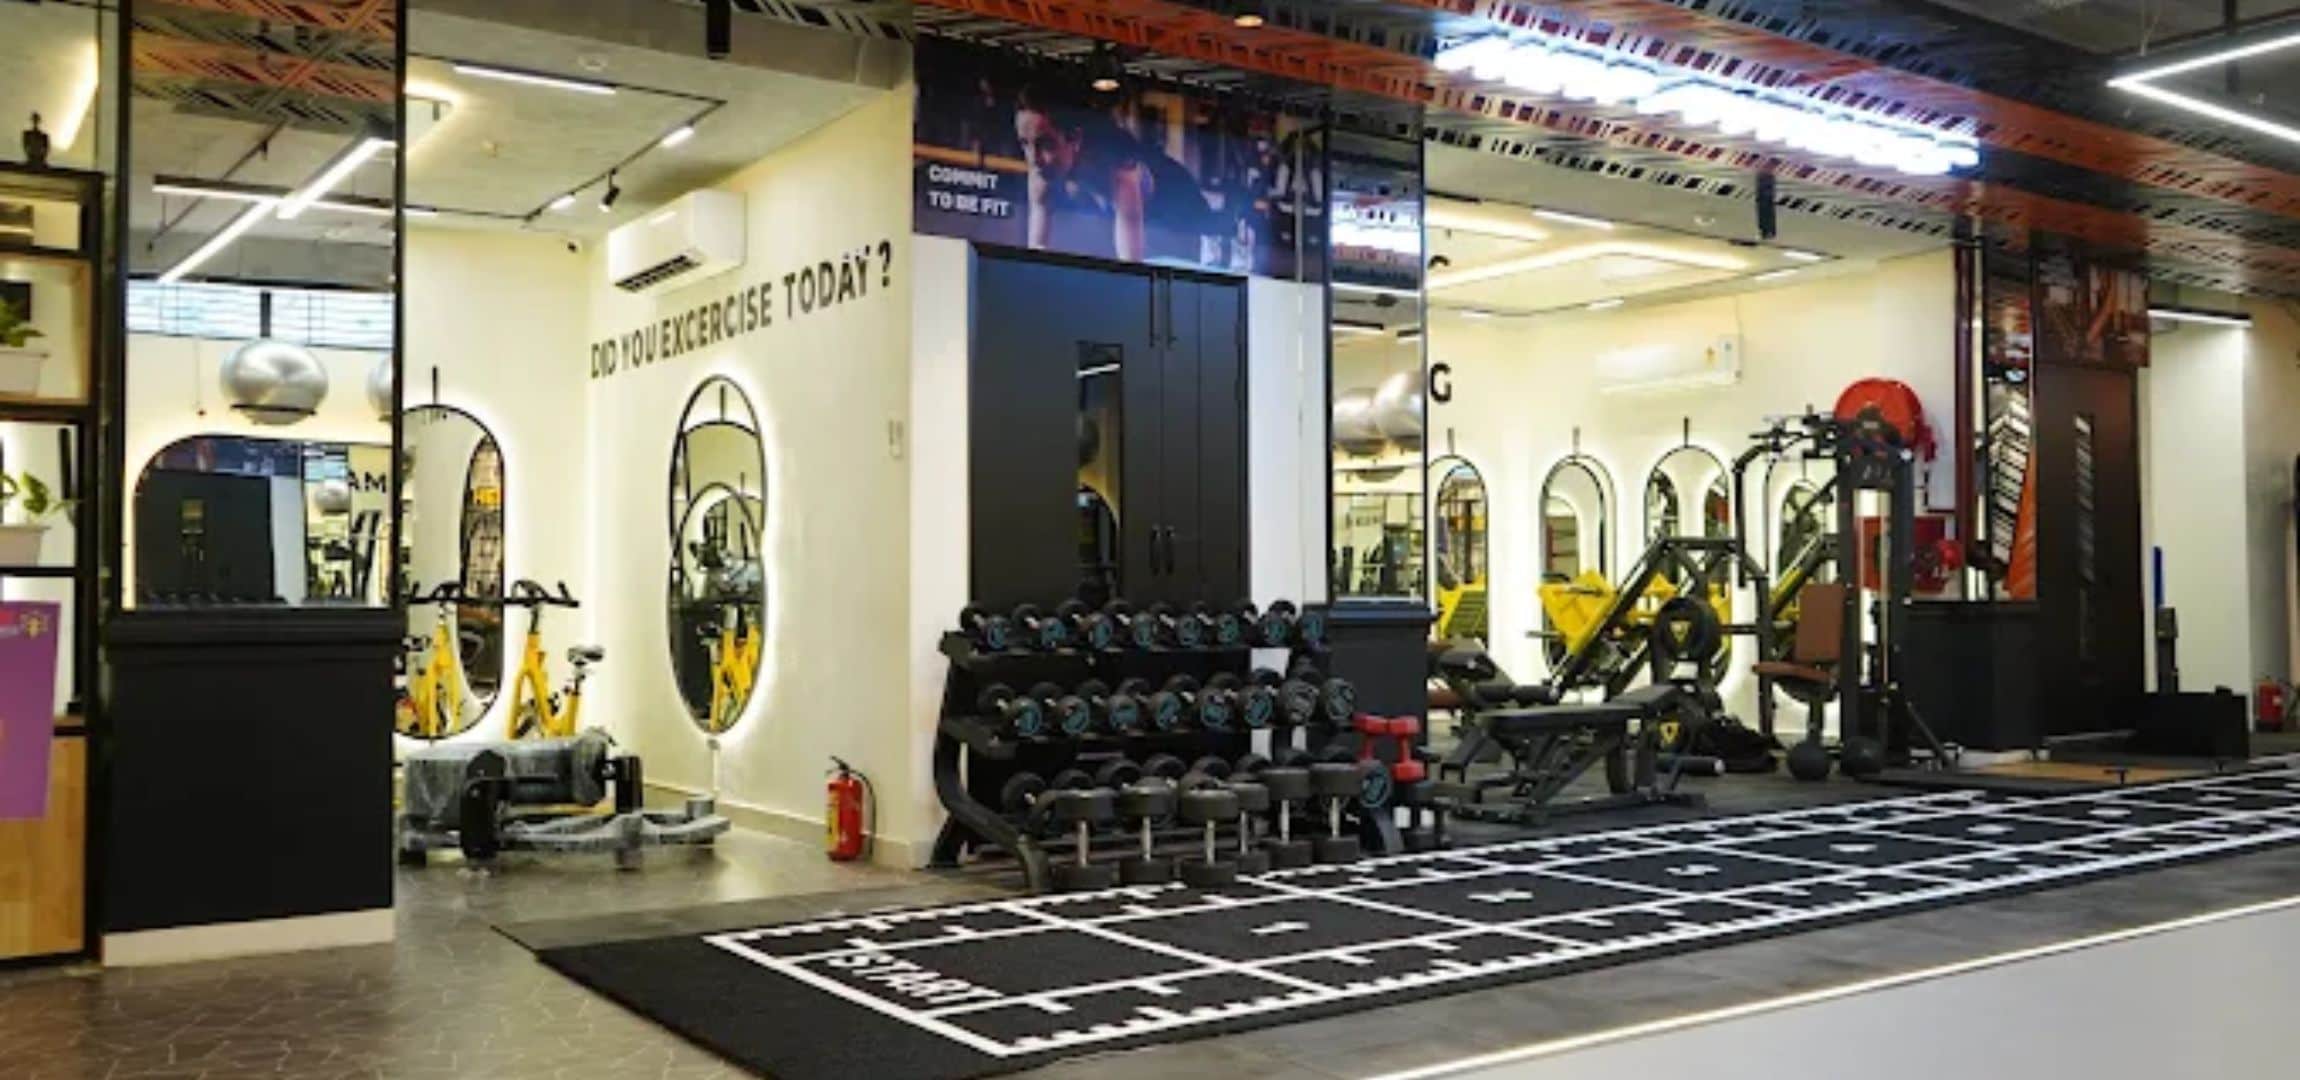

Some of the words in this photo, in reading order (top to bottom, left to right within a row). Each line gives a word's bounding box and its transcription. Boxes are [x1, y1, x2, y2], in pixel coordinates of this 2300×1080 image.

[929, 164, 998, 190] COMMIT
[928, 191, 952, 210] TO
[955, 194, 979, 213] BE
[980, 197, 1010, 217] FIT
[591, 336, 617, 379] DID
[621, 323, 657, 370] YOU
[661, 282, 772, 358] EXCERCISE
[782, 245, 870, 320] TODAY
[827, 952, 1004, 1004] START
